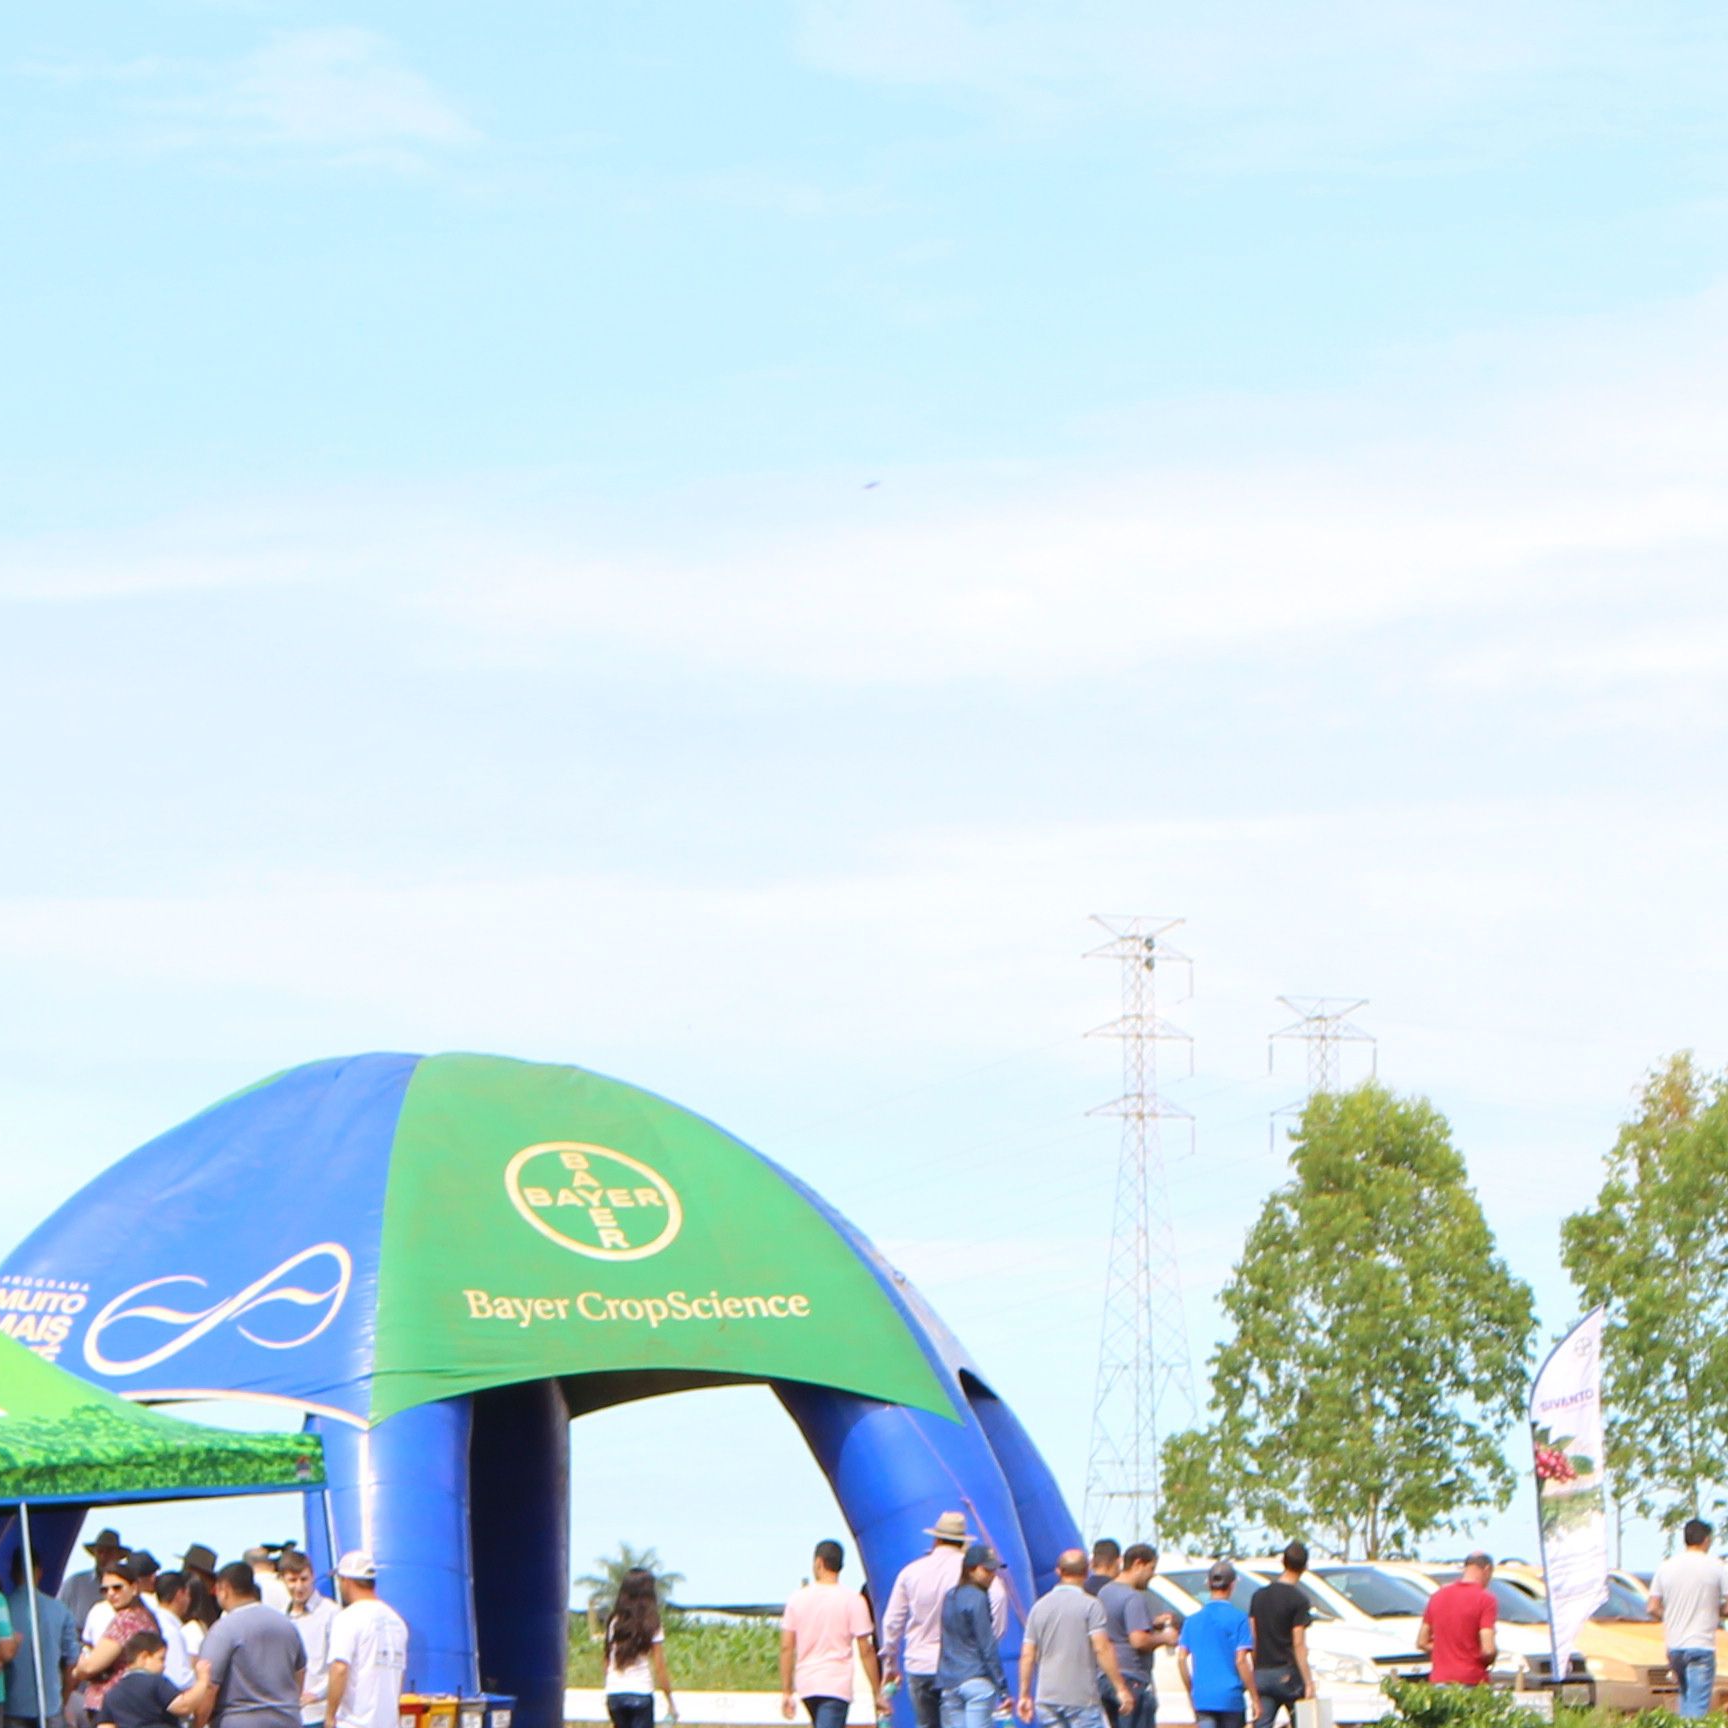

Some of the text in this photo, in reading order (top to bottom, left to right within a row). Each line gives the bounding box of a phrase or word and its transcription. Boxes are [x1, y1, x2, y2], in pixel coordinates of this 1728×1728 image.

[522, 1187, 664, 1208] BAYER
[559, 1151, 631, 1249] BAYER
[462, 1289, 812, 1328] Bayer CropScience
